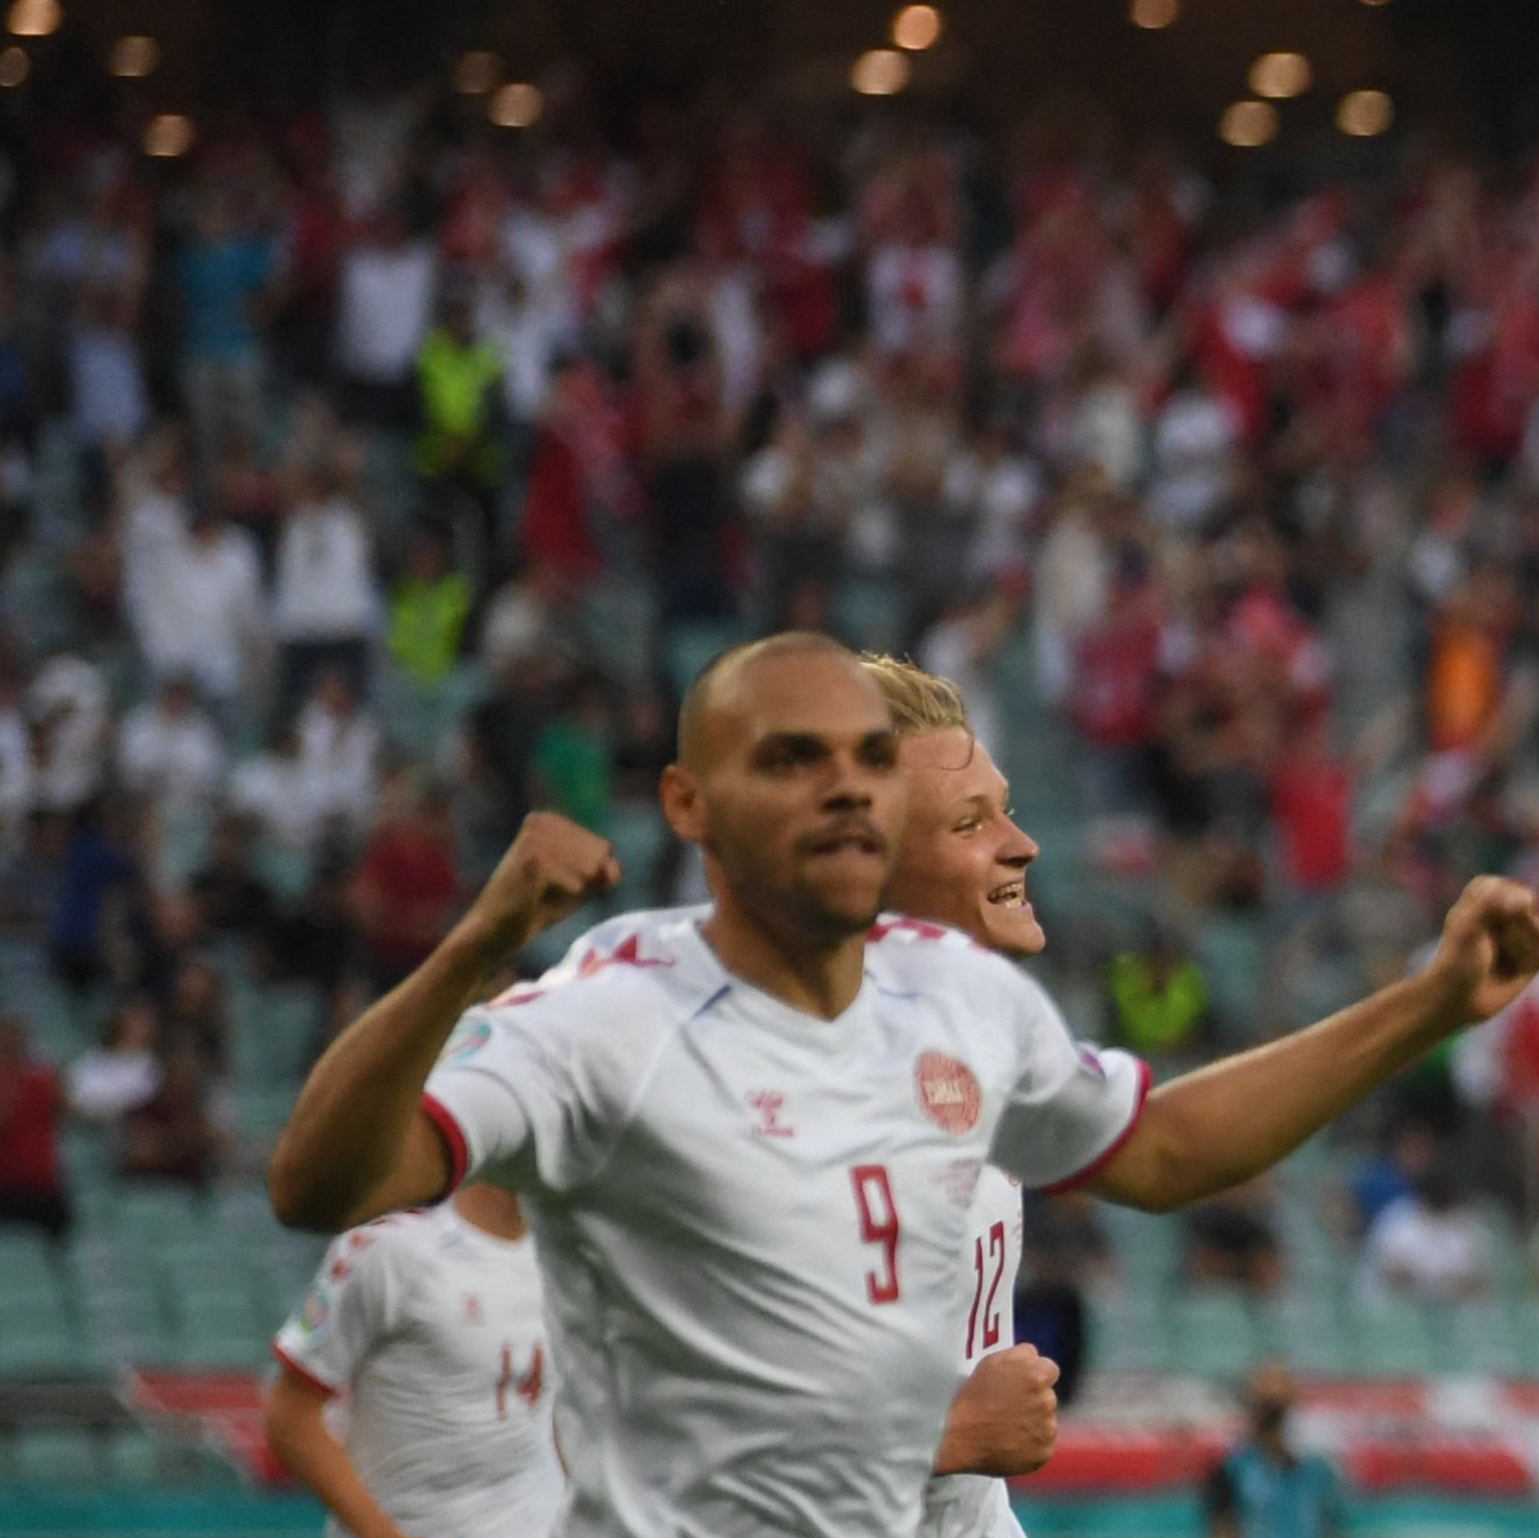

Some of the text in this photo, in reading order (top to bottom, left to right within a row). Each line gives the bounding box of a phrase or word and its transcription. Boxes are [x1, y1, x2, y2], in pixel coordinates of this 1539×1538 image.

[850, 1164, 900, 1305] 9
[965, 1221, 1005, 1360] 12
[496, 1342, 545, 1420] 14
